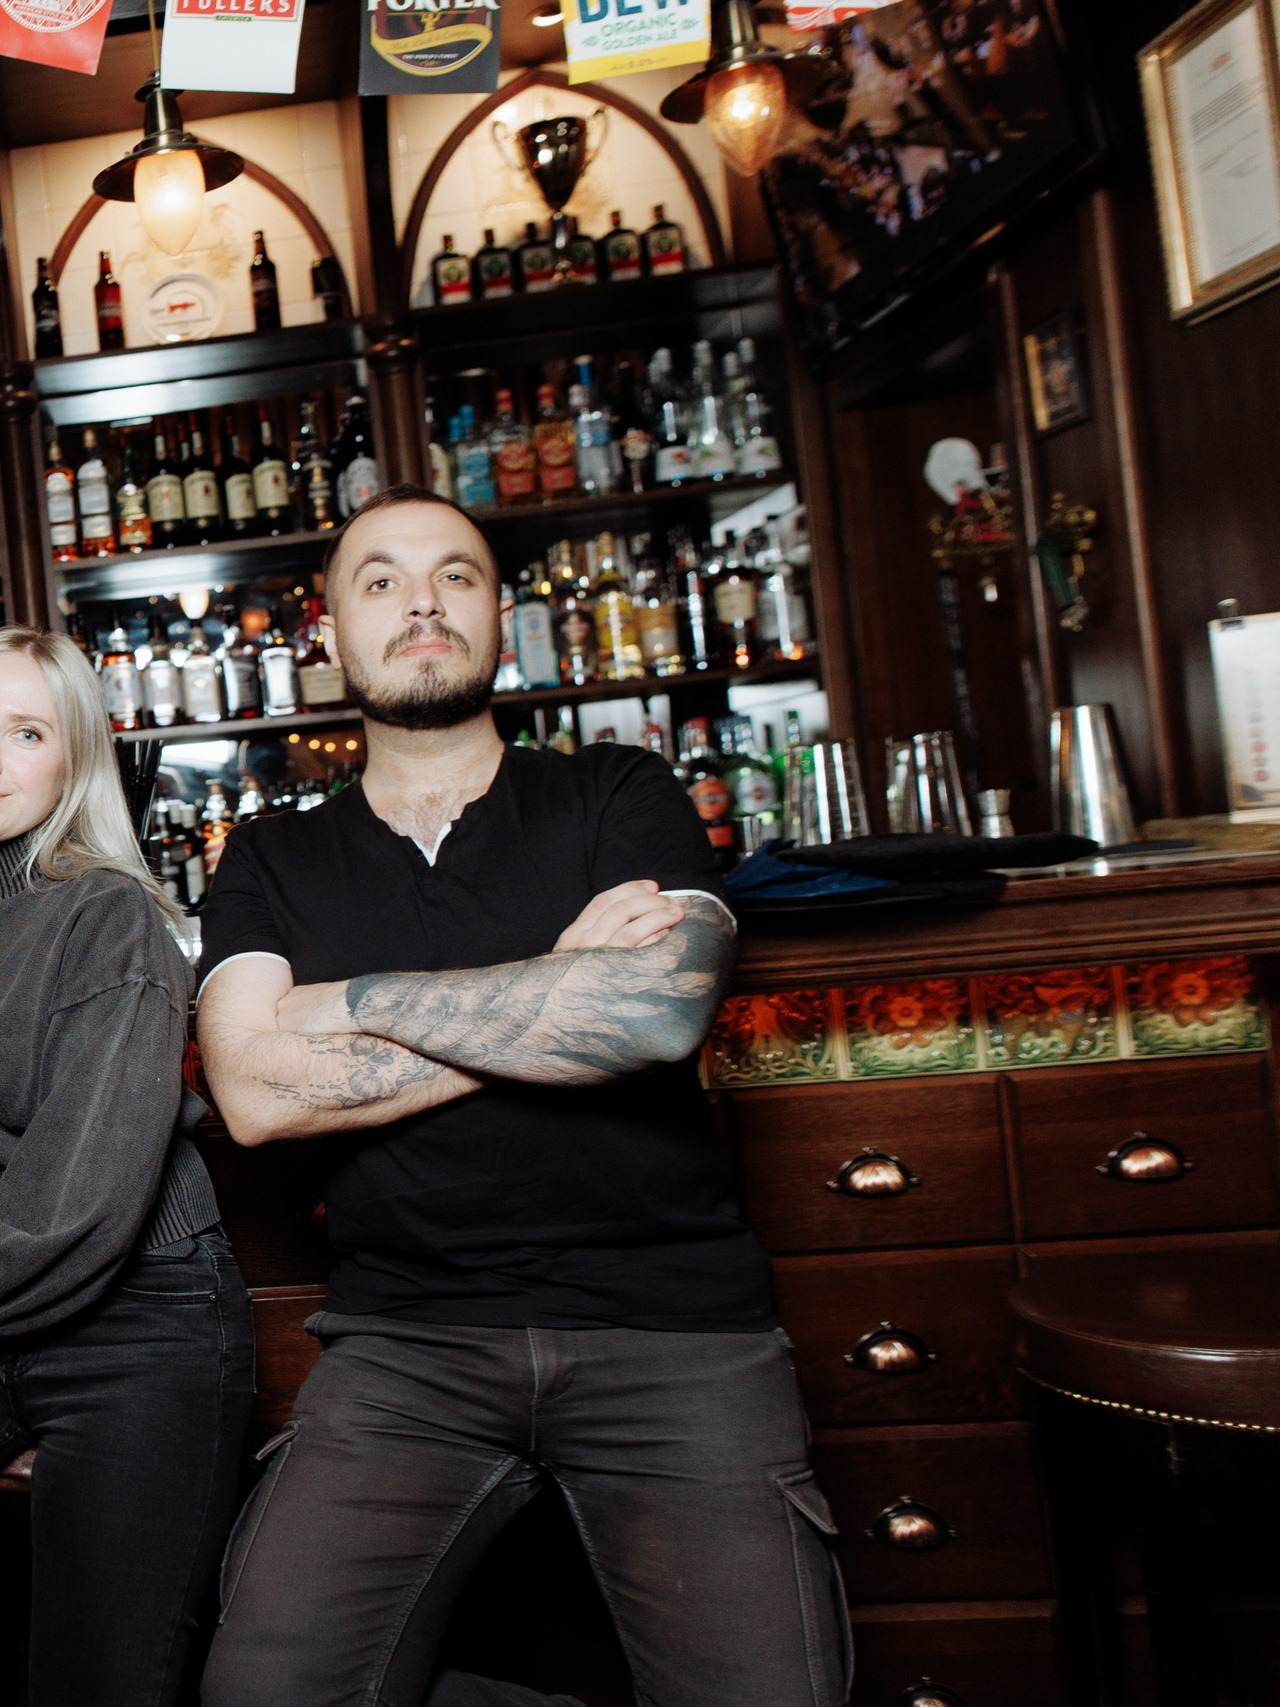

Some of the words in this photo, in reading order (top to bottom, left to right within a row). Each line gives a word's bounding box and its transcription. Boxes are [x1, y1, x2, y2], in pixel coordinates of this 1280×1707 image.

[601, 12, 678, 37] ORGANIC
[602, 34, 653, 50] GOLDEN
[656, 28, 678, 41] ALE
